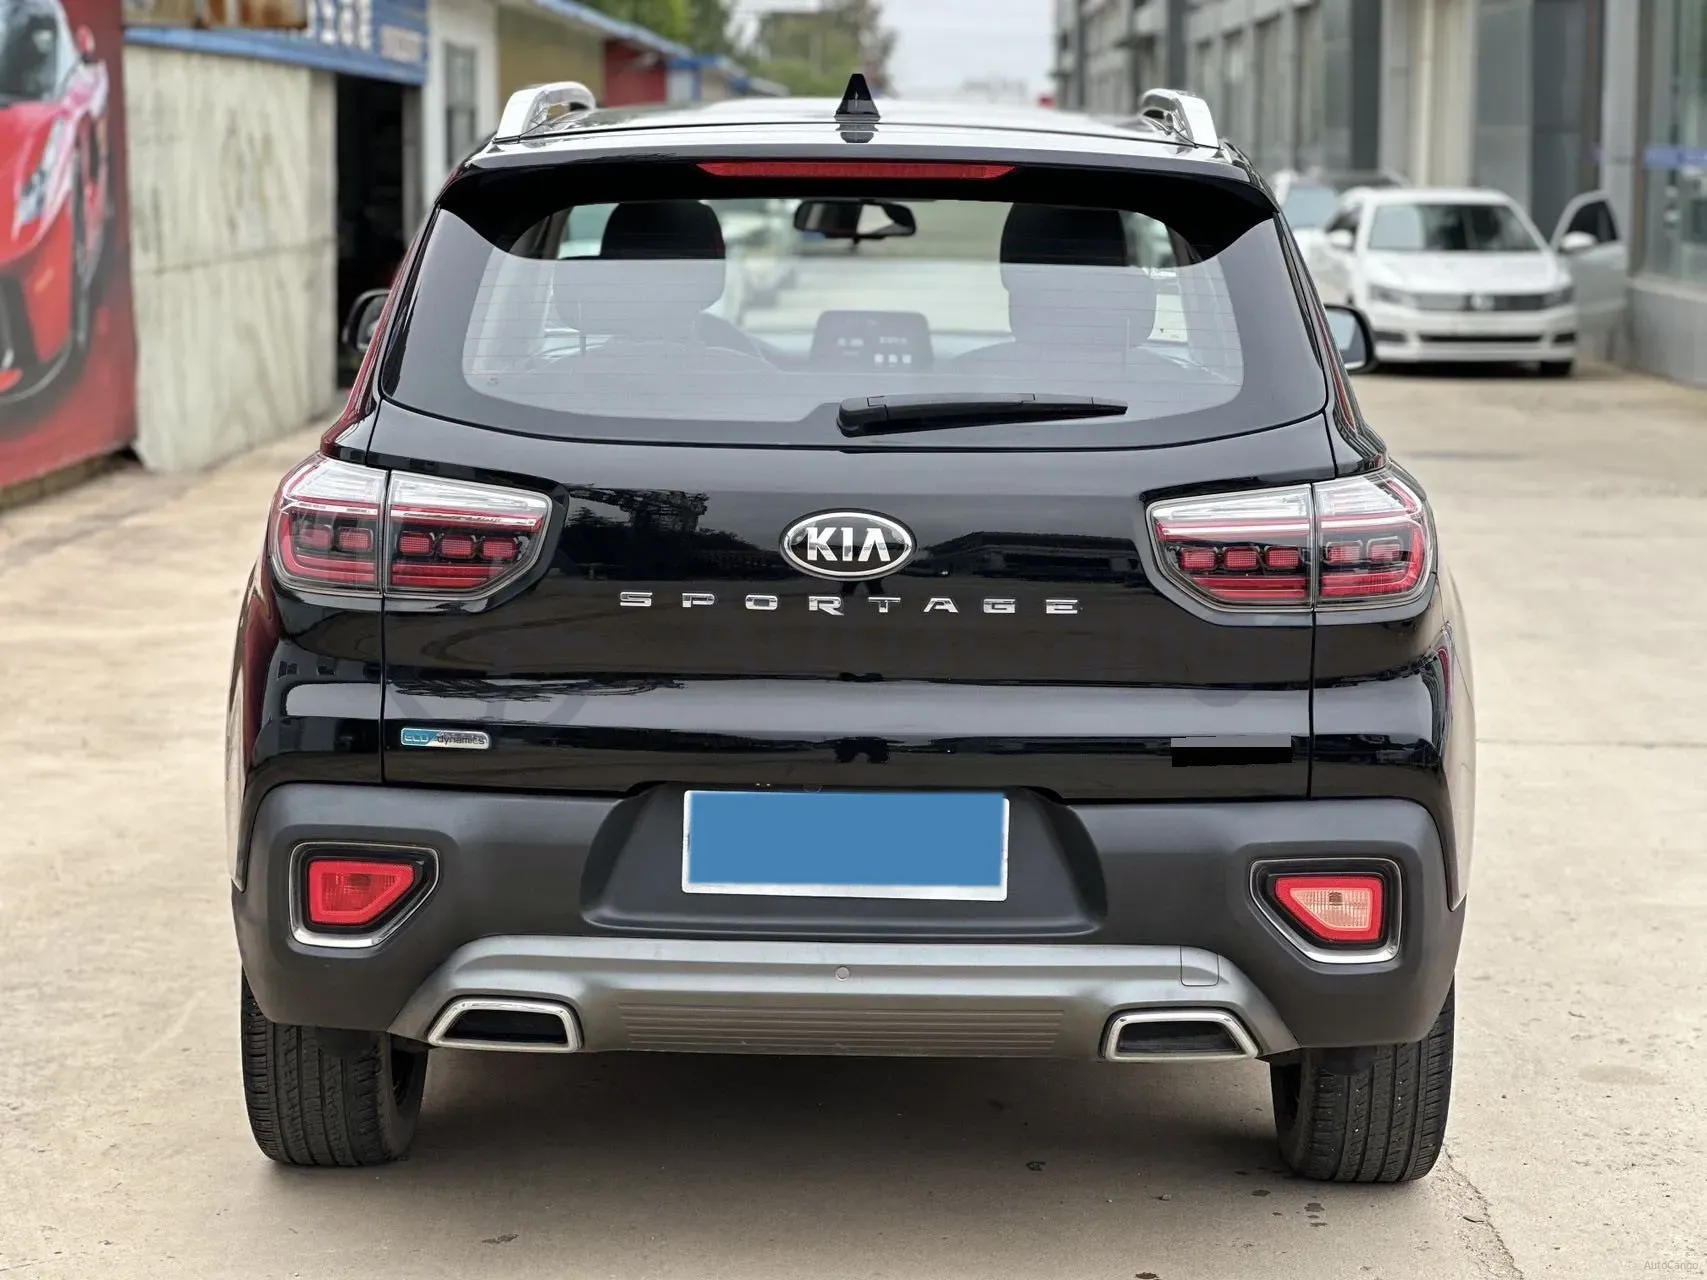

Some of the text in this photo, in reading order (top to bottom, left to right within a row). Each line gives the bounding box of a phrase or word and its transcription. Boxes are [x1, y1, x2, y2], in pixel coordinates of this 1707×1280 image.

[807, 526, 891, 562] KIA
[619, 592, 1079, 616] SPORTAGE
[437, 733, 485, 745] dynamics
